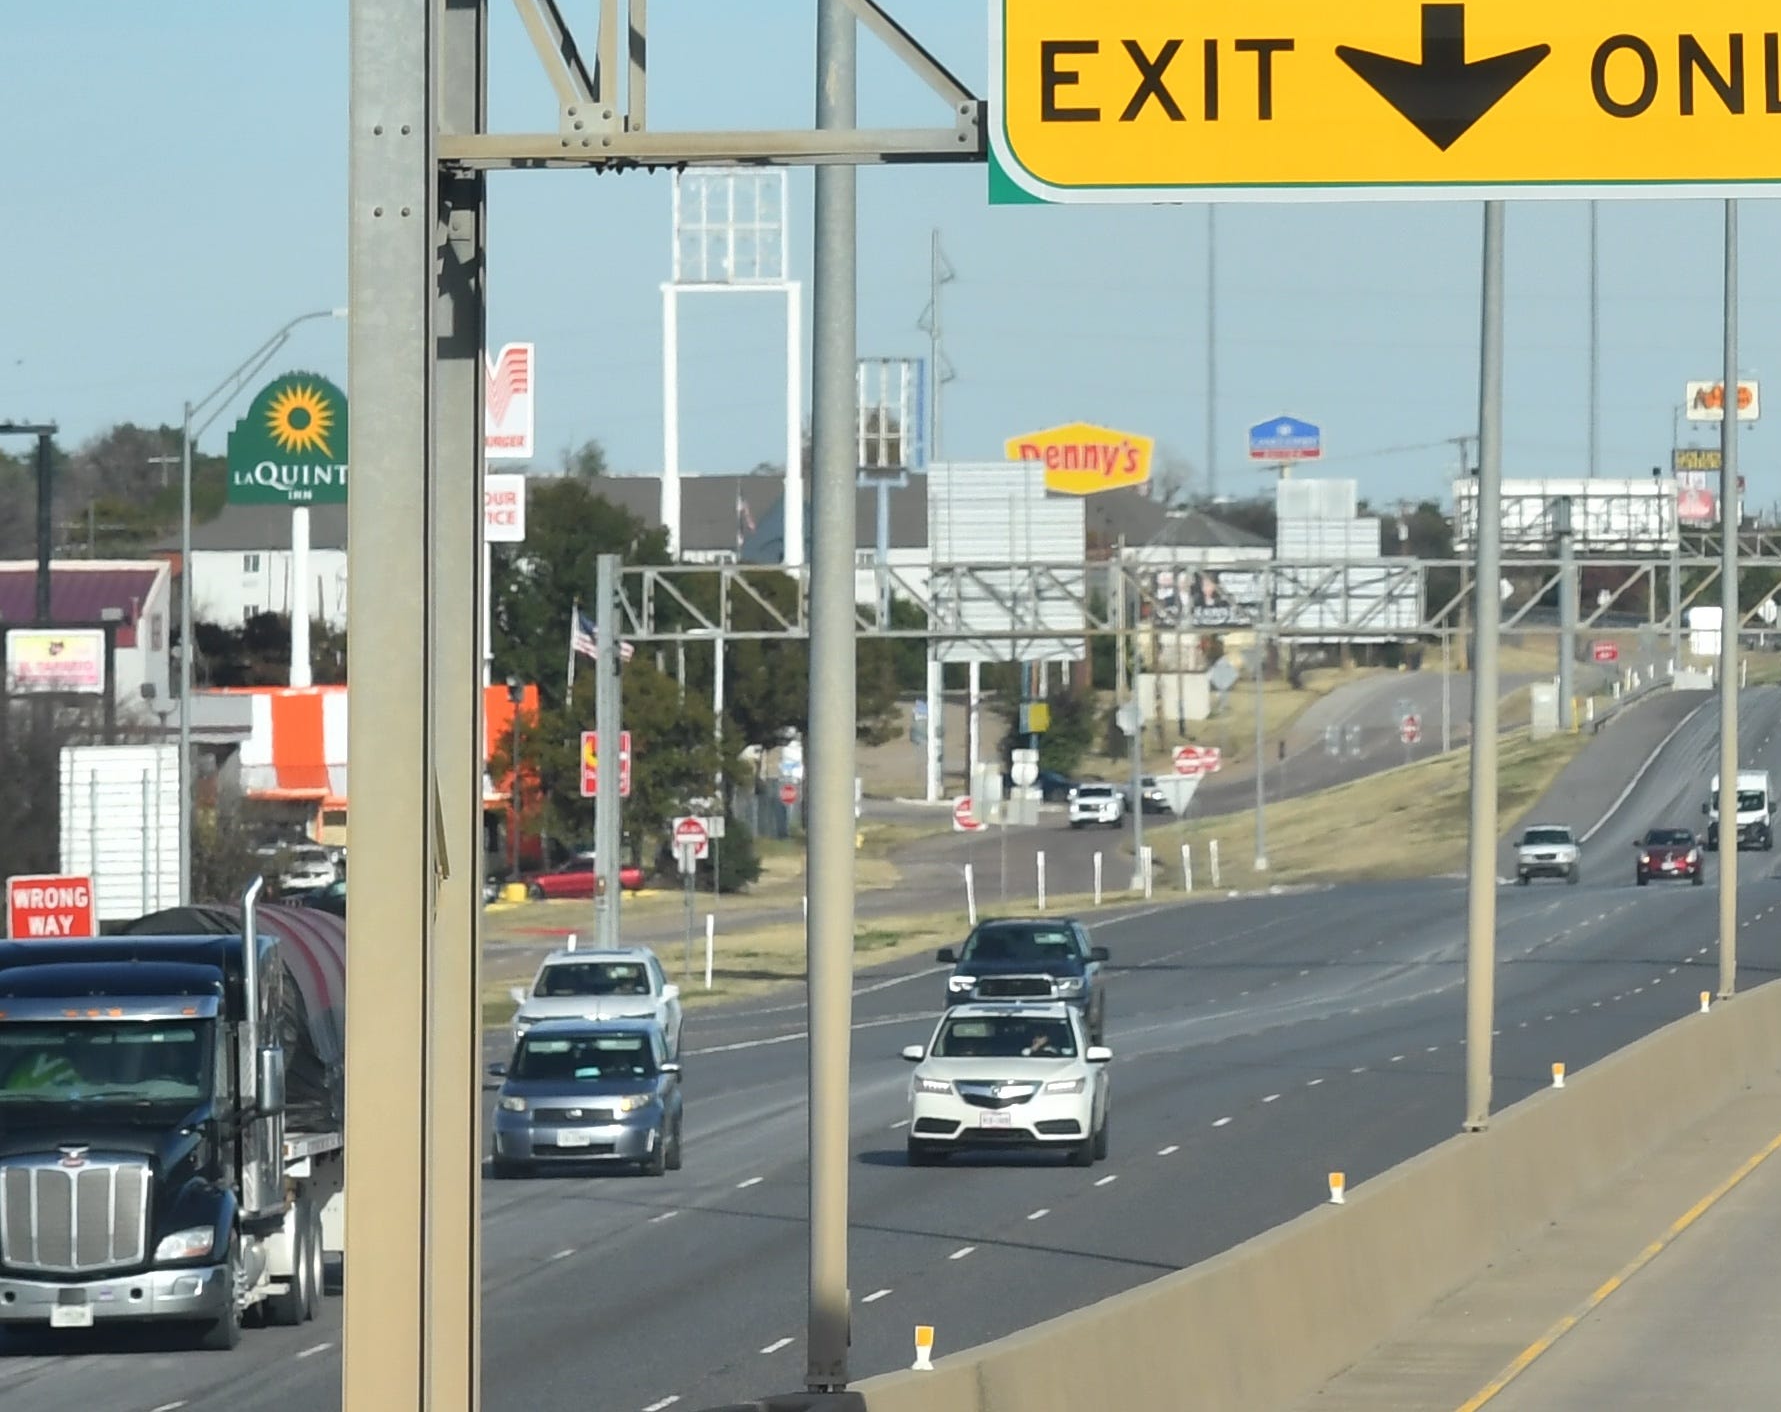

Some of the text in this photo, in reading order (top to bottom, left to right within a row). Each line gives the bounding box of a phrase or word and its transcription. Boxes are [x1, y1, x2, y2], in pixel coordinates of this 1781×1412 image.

[1040, 38, 1294, 122] EXIT
[1020, 441, 1140, 476] Denny's
[255, 460, 347, 491] QUINT
[13, 886, 89, 909] WRONG
[28, 914, 74, 936] WAY
